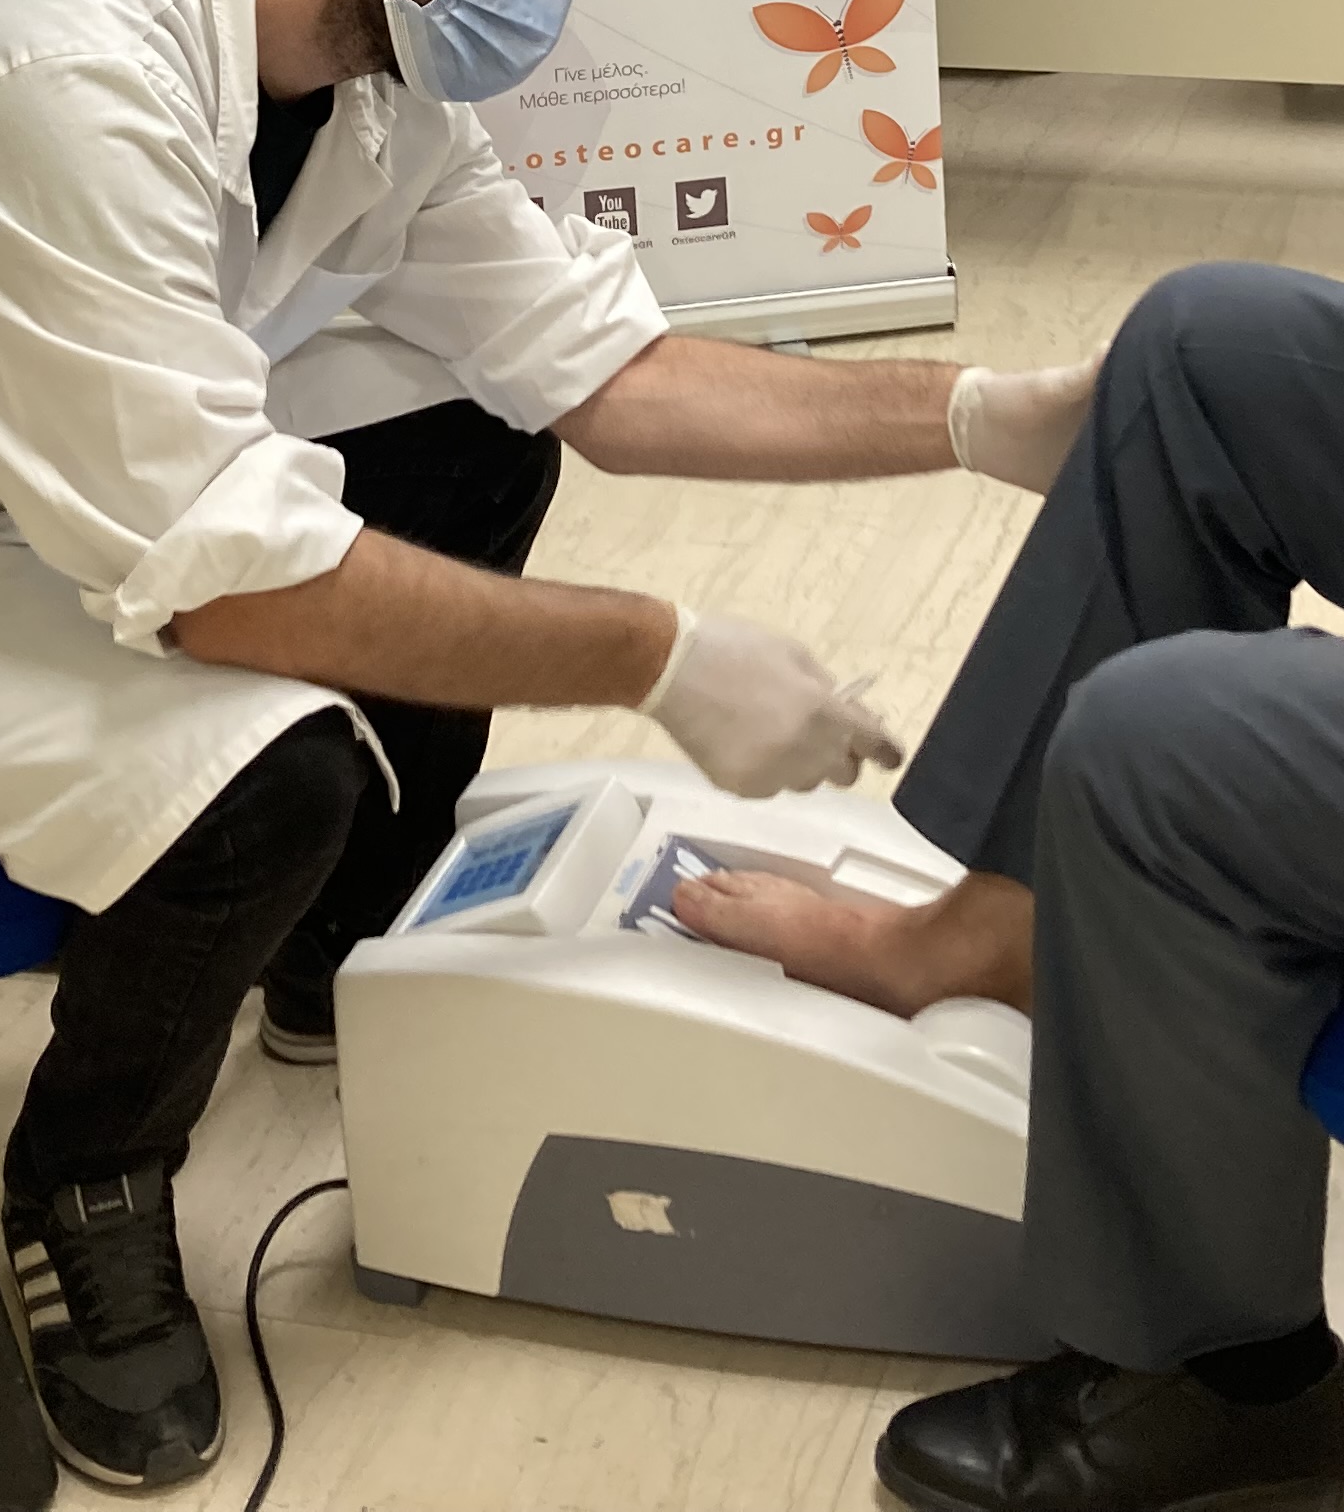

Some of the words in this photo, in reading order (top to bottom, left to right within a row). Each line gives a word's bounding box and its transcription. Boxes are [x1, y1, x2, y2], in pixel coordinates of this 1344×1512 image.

[554, 66, 588, 84] Γίνε
[591, 62, 649, 83] μέλος.
[519, 91, 570, 110] Μάθε
[573, 78, 686, 105] περισσότερα!
[598, 194, 623, 212] You
